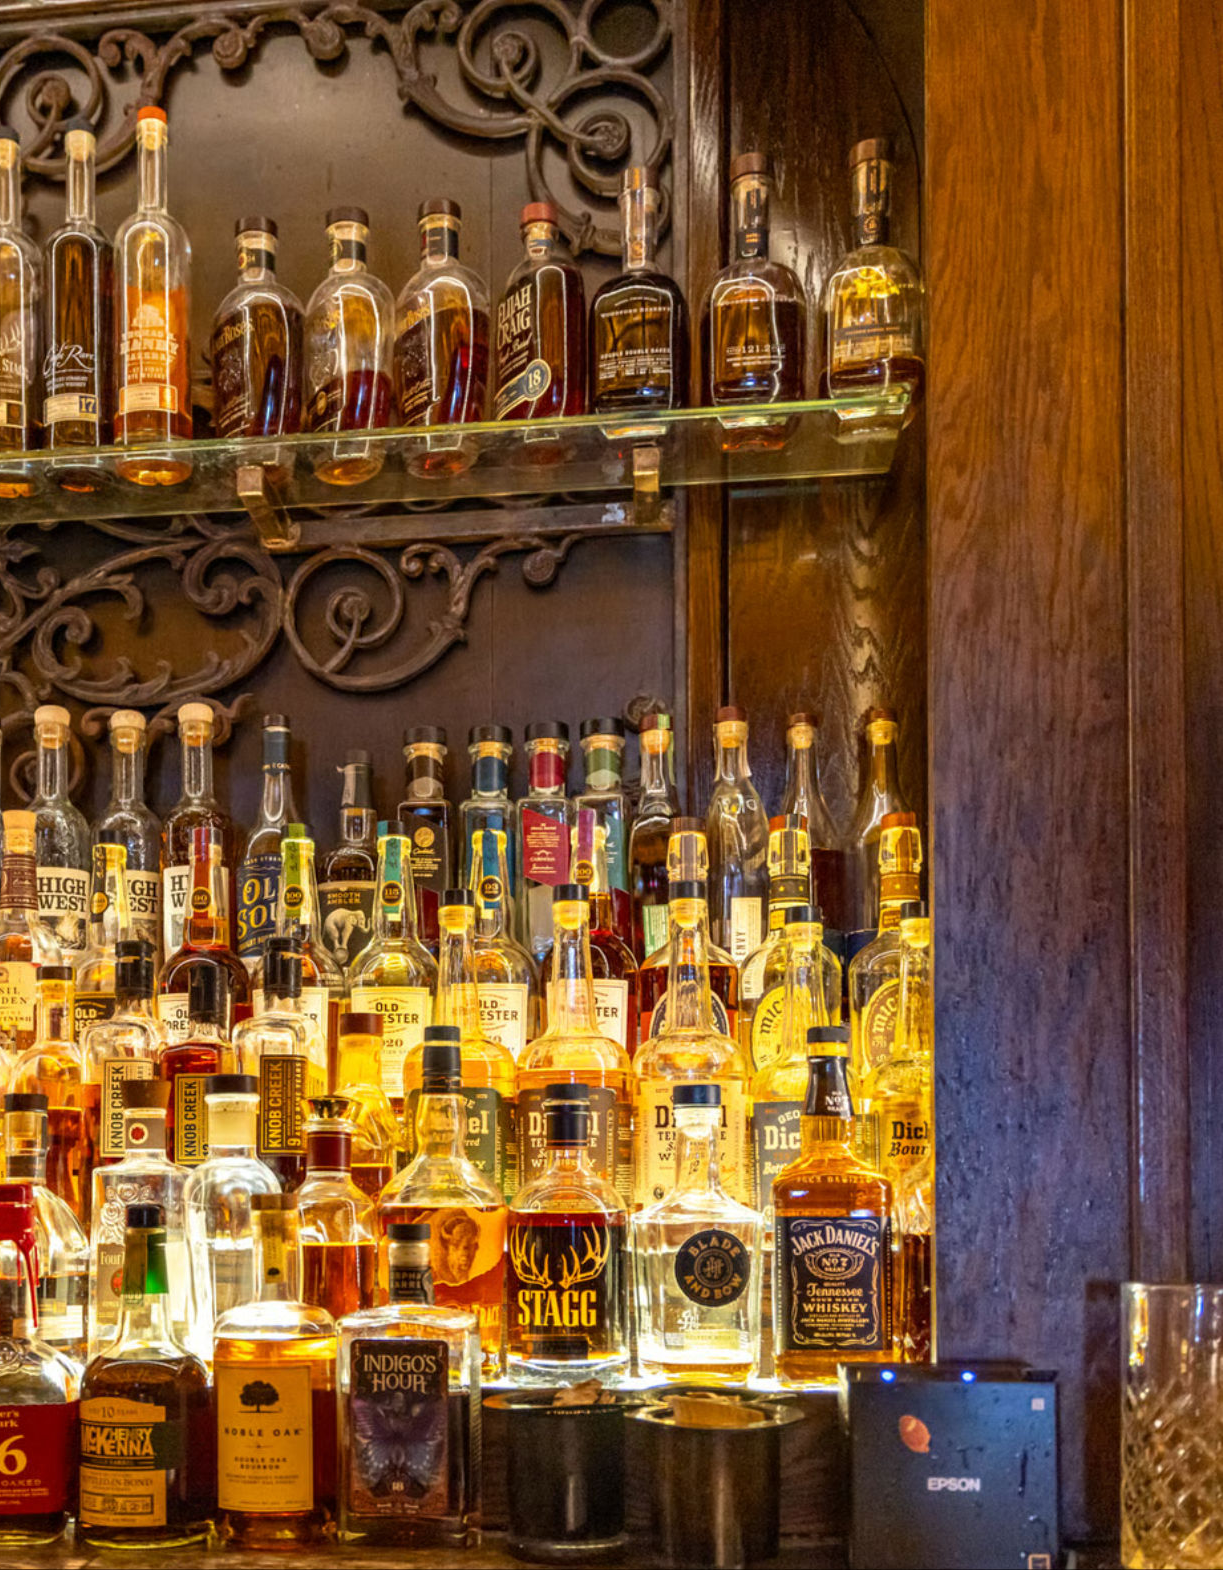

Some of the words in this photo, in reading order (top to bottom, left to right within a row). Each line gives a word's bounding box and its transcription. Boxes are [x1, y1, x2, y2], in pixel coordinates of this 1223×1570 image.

[498, 284, 533, 324] ELIJAH
[497, 307, 531, 350] CRAIG
[120, 339, 179, 355] HANDY
[528, 369, 542, 389] 18
[80, 397, 96, 412] 17
[37, 877, 87, 897] HIGH
[128, 879, 157, 898] IGH
[242, 877, 276, 905] OL
[384, 888, 399, 896] 115
[37, 897, 87, 912] WEST
[130, 899, 158, 913] EST
[735, 930, 747, 957] ENVY
[75, 1008, 97, 1019] OLD
[375, 1002, 399, 1013] OLD
[479, 1010, 519, 1022] ESTER
[383, 1013, 420, 1024] ESTER
[111, 1064, 125, 1110] CREEK
[269, 1061, 283, 1110] CREEK
[185, 1081, 197, 1116] CREEK
[777, 1110, 800, 1126] GEO
[111, 1111, 124, 1149] KNOB
[185, 1118, 197, 1157] KNOB
[268, 1111, 283, 1149] KNOB
[287, 1132, 301, 1147] 9
[763, 1125, 800, 1150] Dic
[892, 1121, 927, 1140] Dic
[888, 1142, 927, 1157] Bour
[688, 1236, 741, 1257] BLADE
[791, 1230, 823, 1256] JACK
[825, 1225, 880, 1258] DANIEL'S
[100, 1251, 122, 1265] Four
[684, 1275, 711, 1299] AND
[713, 1273, 743, 1300] BOW
[807, 1283, 864, 1297] Tennessee
[517, 1290, 597, 1327] STAGG
[802, 1303, 868, 1313] WHISKEY
[364, 1354, 437, 1373] INDIGO'S
[372, 1373, 427, 1394] HOUR
[101, 1406, 115, 1419] 10
[109, 1427, 154, 1441] HENRY
[224, 1427, 264, 1437] NOBLE
[272, 1428, 300, 1437] OAK
[0, 1479, 42, 1487] OAKED
[927, 1477, 981, 1491] EPSON
